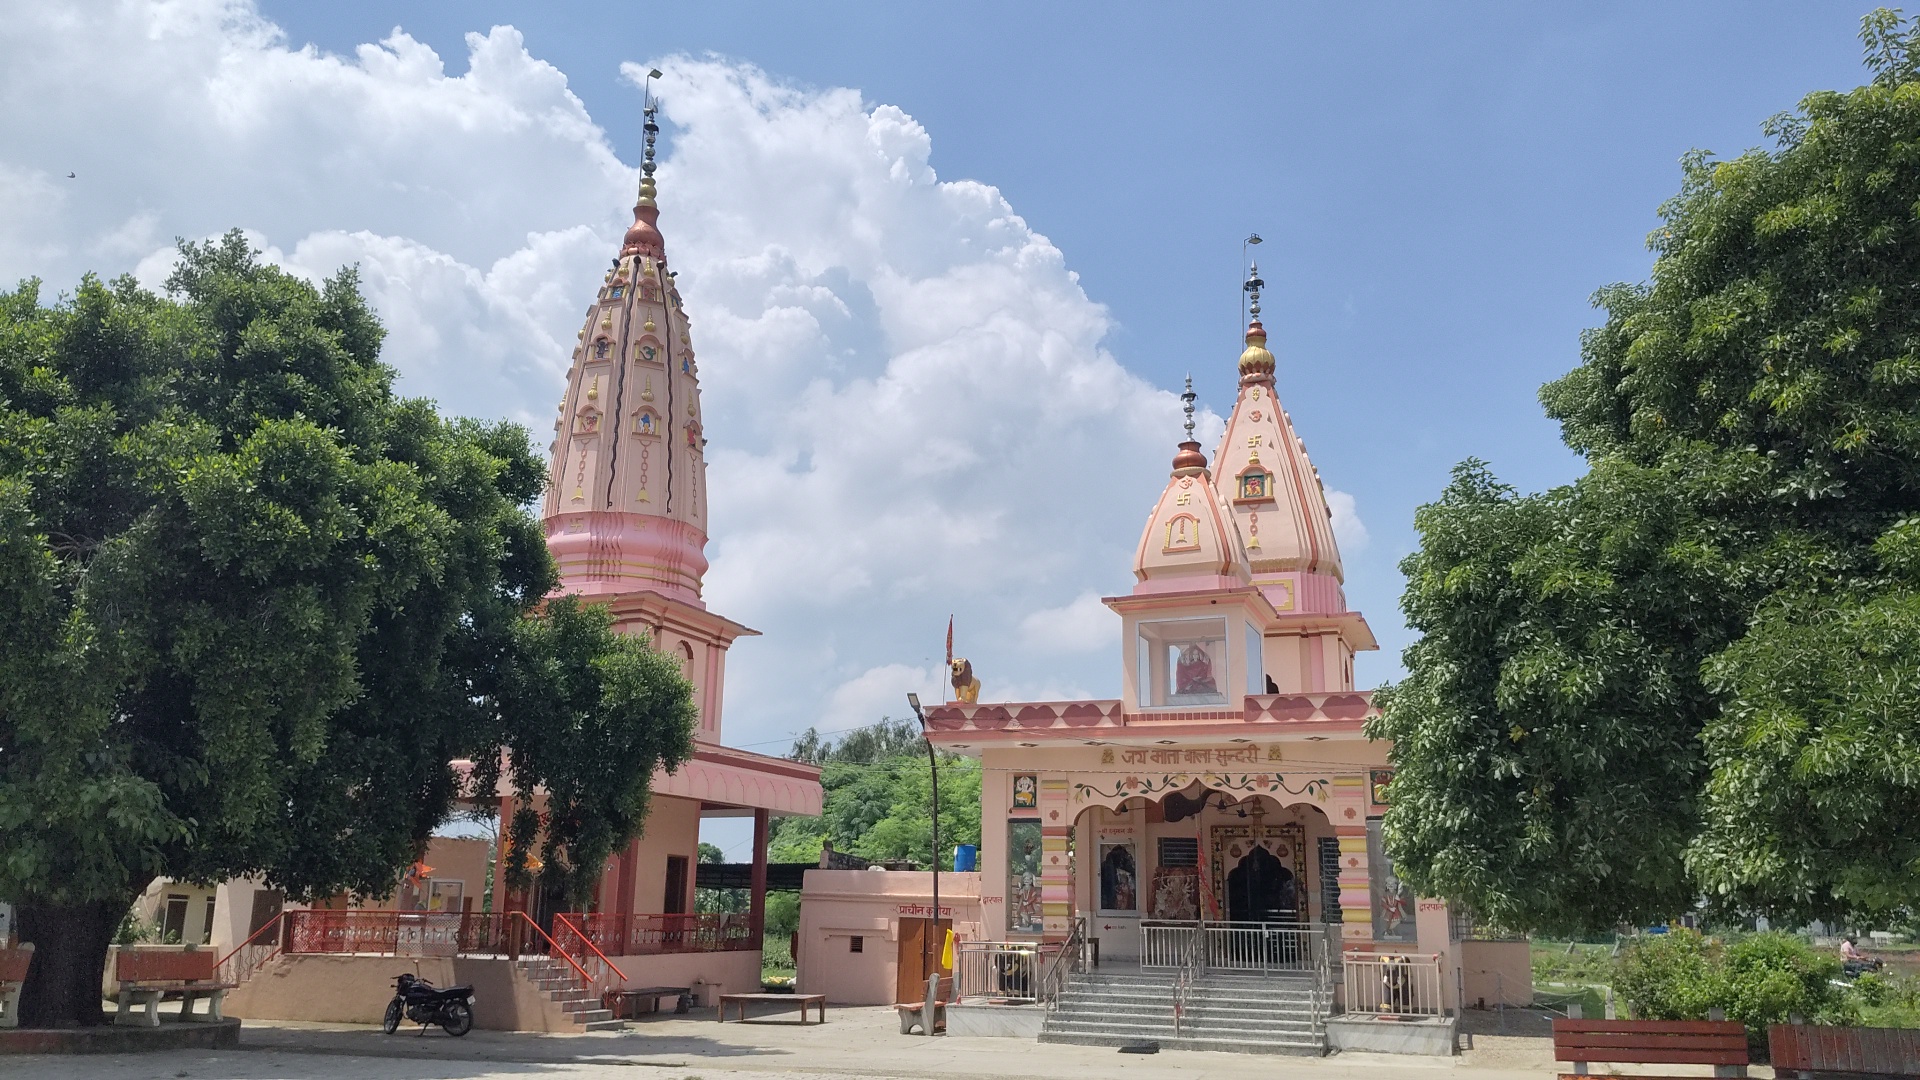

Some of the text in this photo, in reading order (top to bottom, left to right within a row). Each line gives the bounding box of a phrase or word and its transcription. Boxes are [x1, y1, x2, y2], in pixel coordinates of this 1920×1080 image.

[1121, 744, 1260, 766] जय माता बाला सुन्दरी
[899, 903, 951, 917] प्राचीन कुीया
